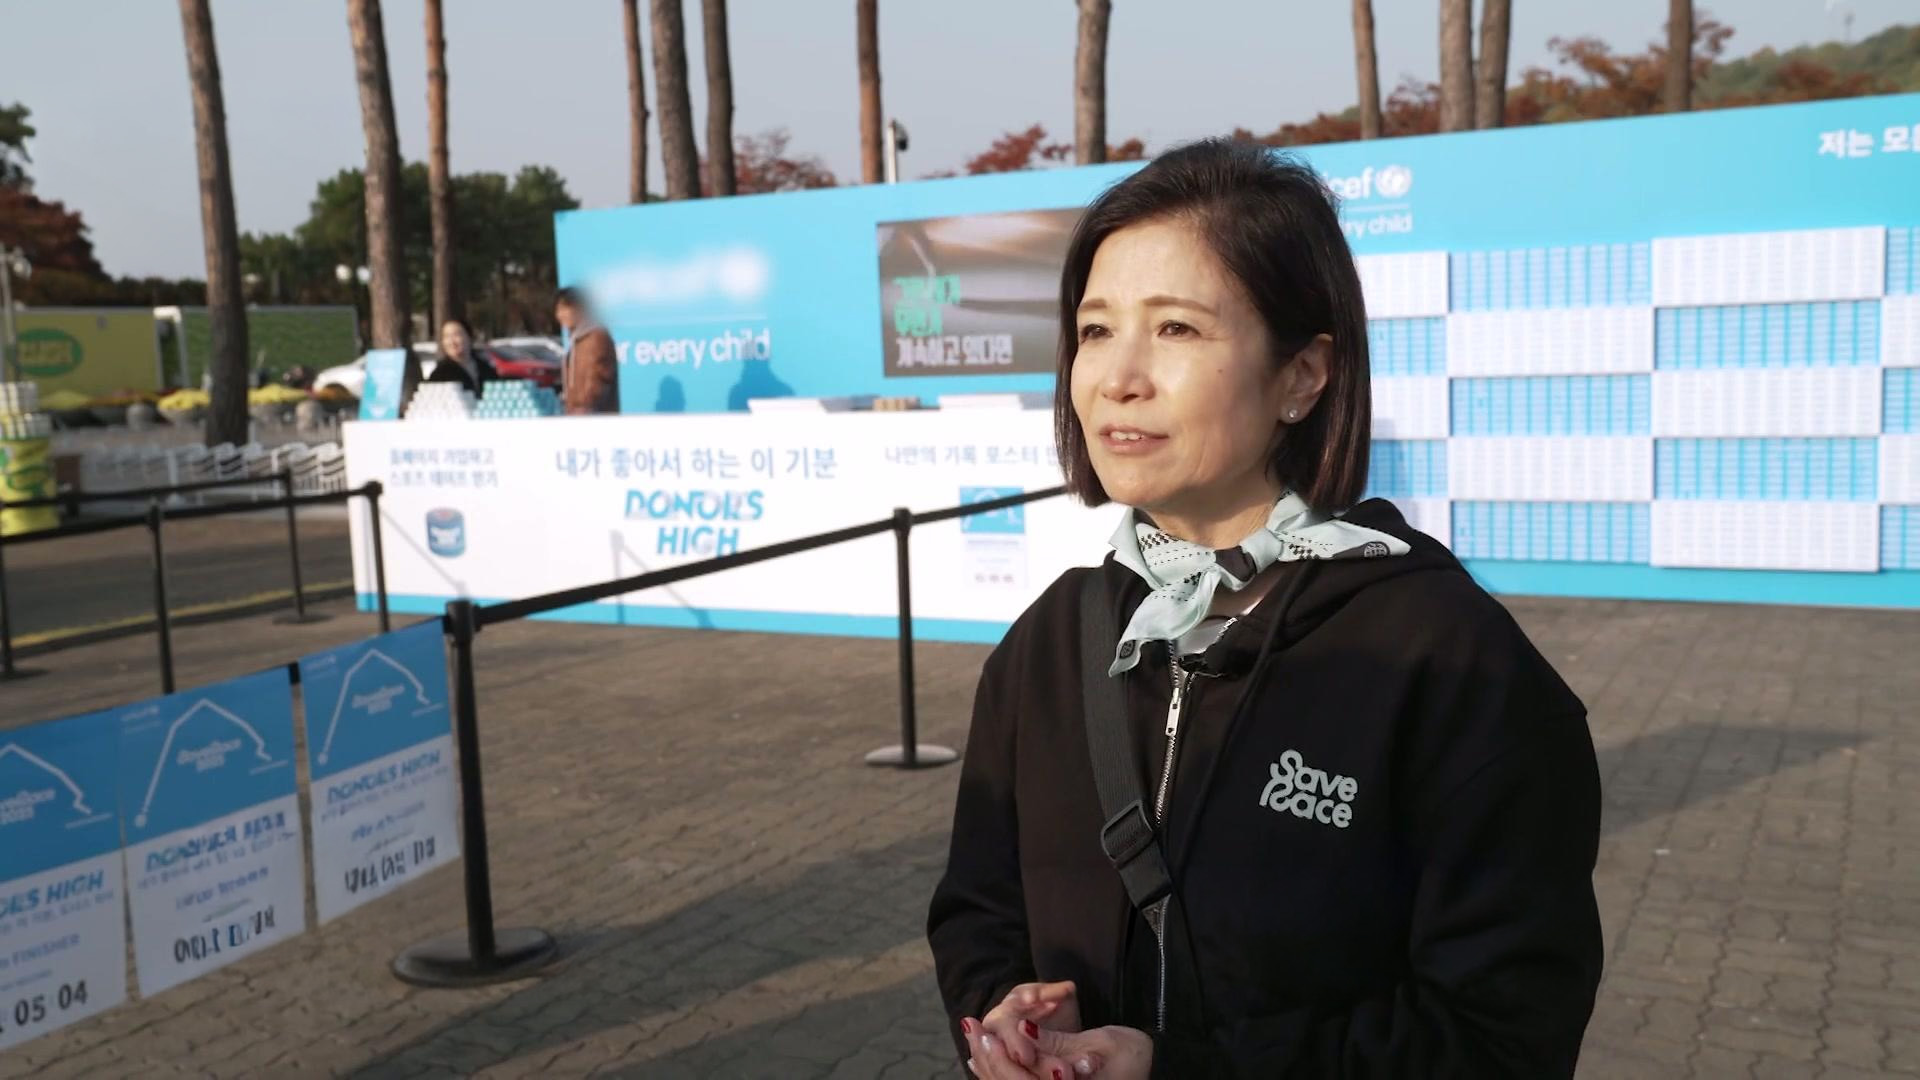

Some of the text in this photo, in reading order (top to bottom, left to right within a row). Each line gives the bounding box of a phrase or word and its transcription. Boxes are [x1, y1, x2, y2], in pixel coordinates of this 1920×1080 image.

[1818, 128, 1874, 159] 저는
[1367, 213, 1412, 235] child
[634, 338, 706, 370] every
[709, 327, 770, 363] child
[555, 447, 838, 479] 내가 좋아서 하는 이 기분
[656, 526, 740, 557] HIGH
[1269, 749, 1358, 802] Save
[1259, 777, 1353, 828] Race
[46, 869, 105, 905] HIGH
[14, 993, 46, 1026] 05
[57, 979, 88, 1010] 04
